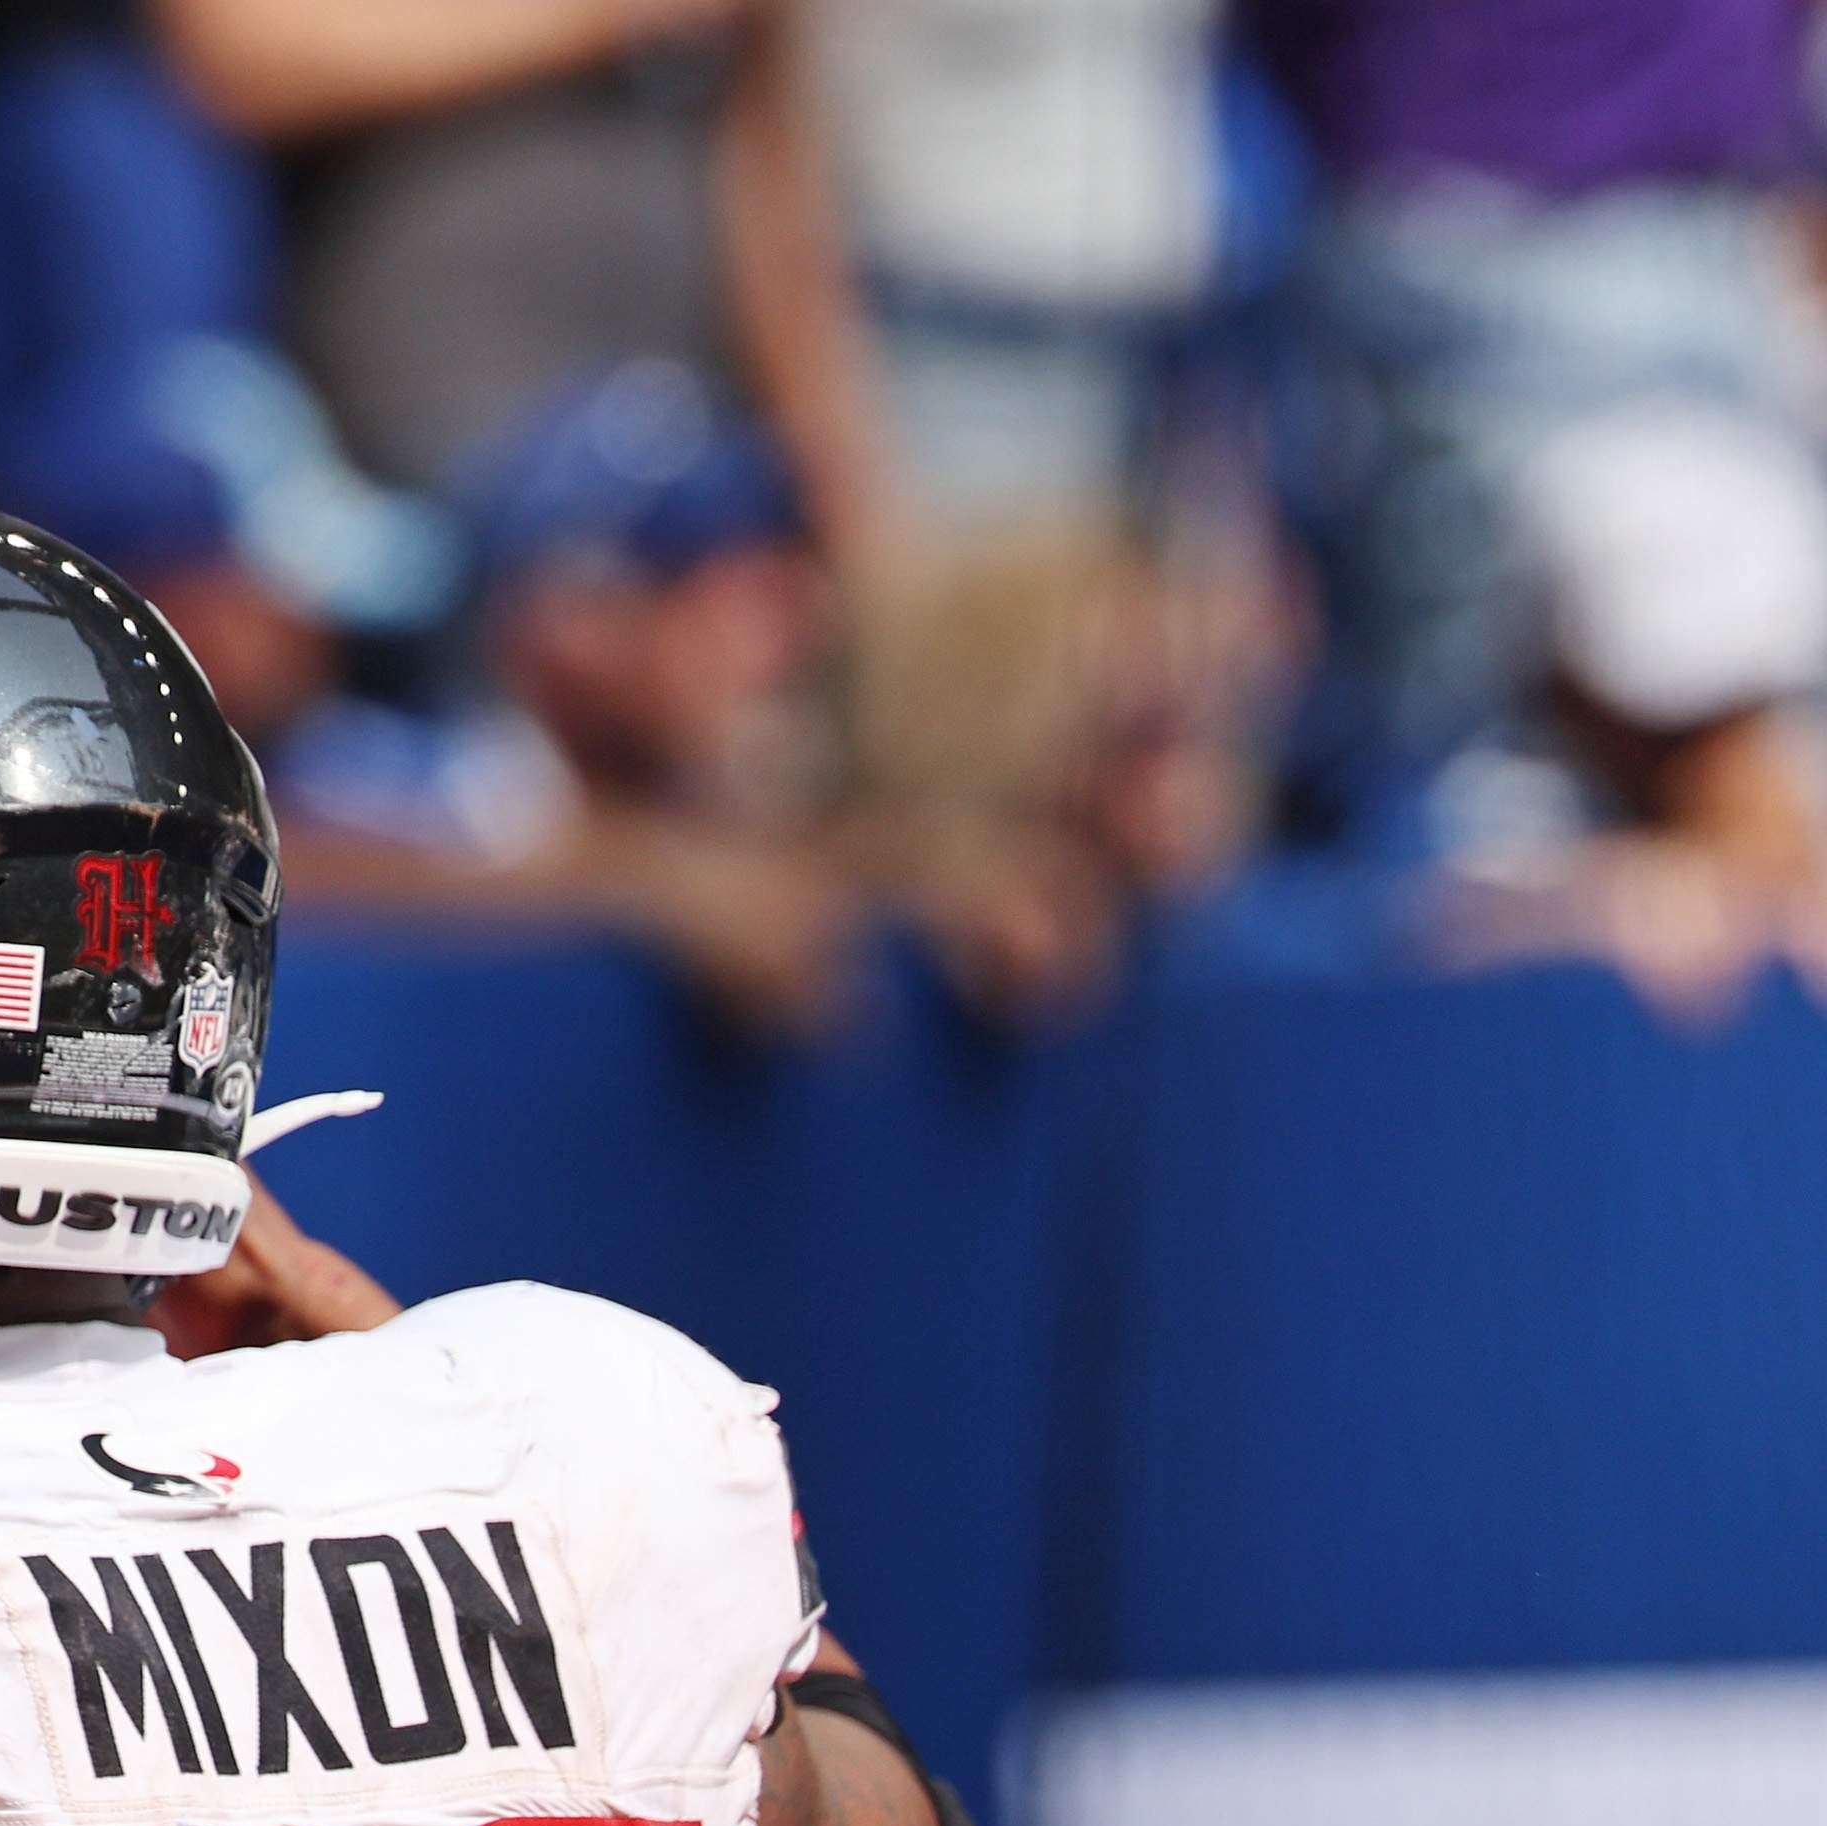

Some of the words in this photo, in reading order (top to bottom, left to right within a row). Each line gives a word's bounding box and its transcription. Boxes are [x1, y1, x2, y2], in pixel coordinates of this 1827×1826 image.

[82, 1030, 149, 1043] WARNING
[189, 1013, 226, 1057] NFL
[20, 1521, 577, 1779] MIXON
